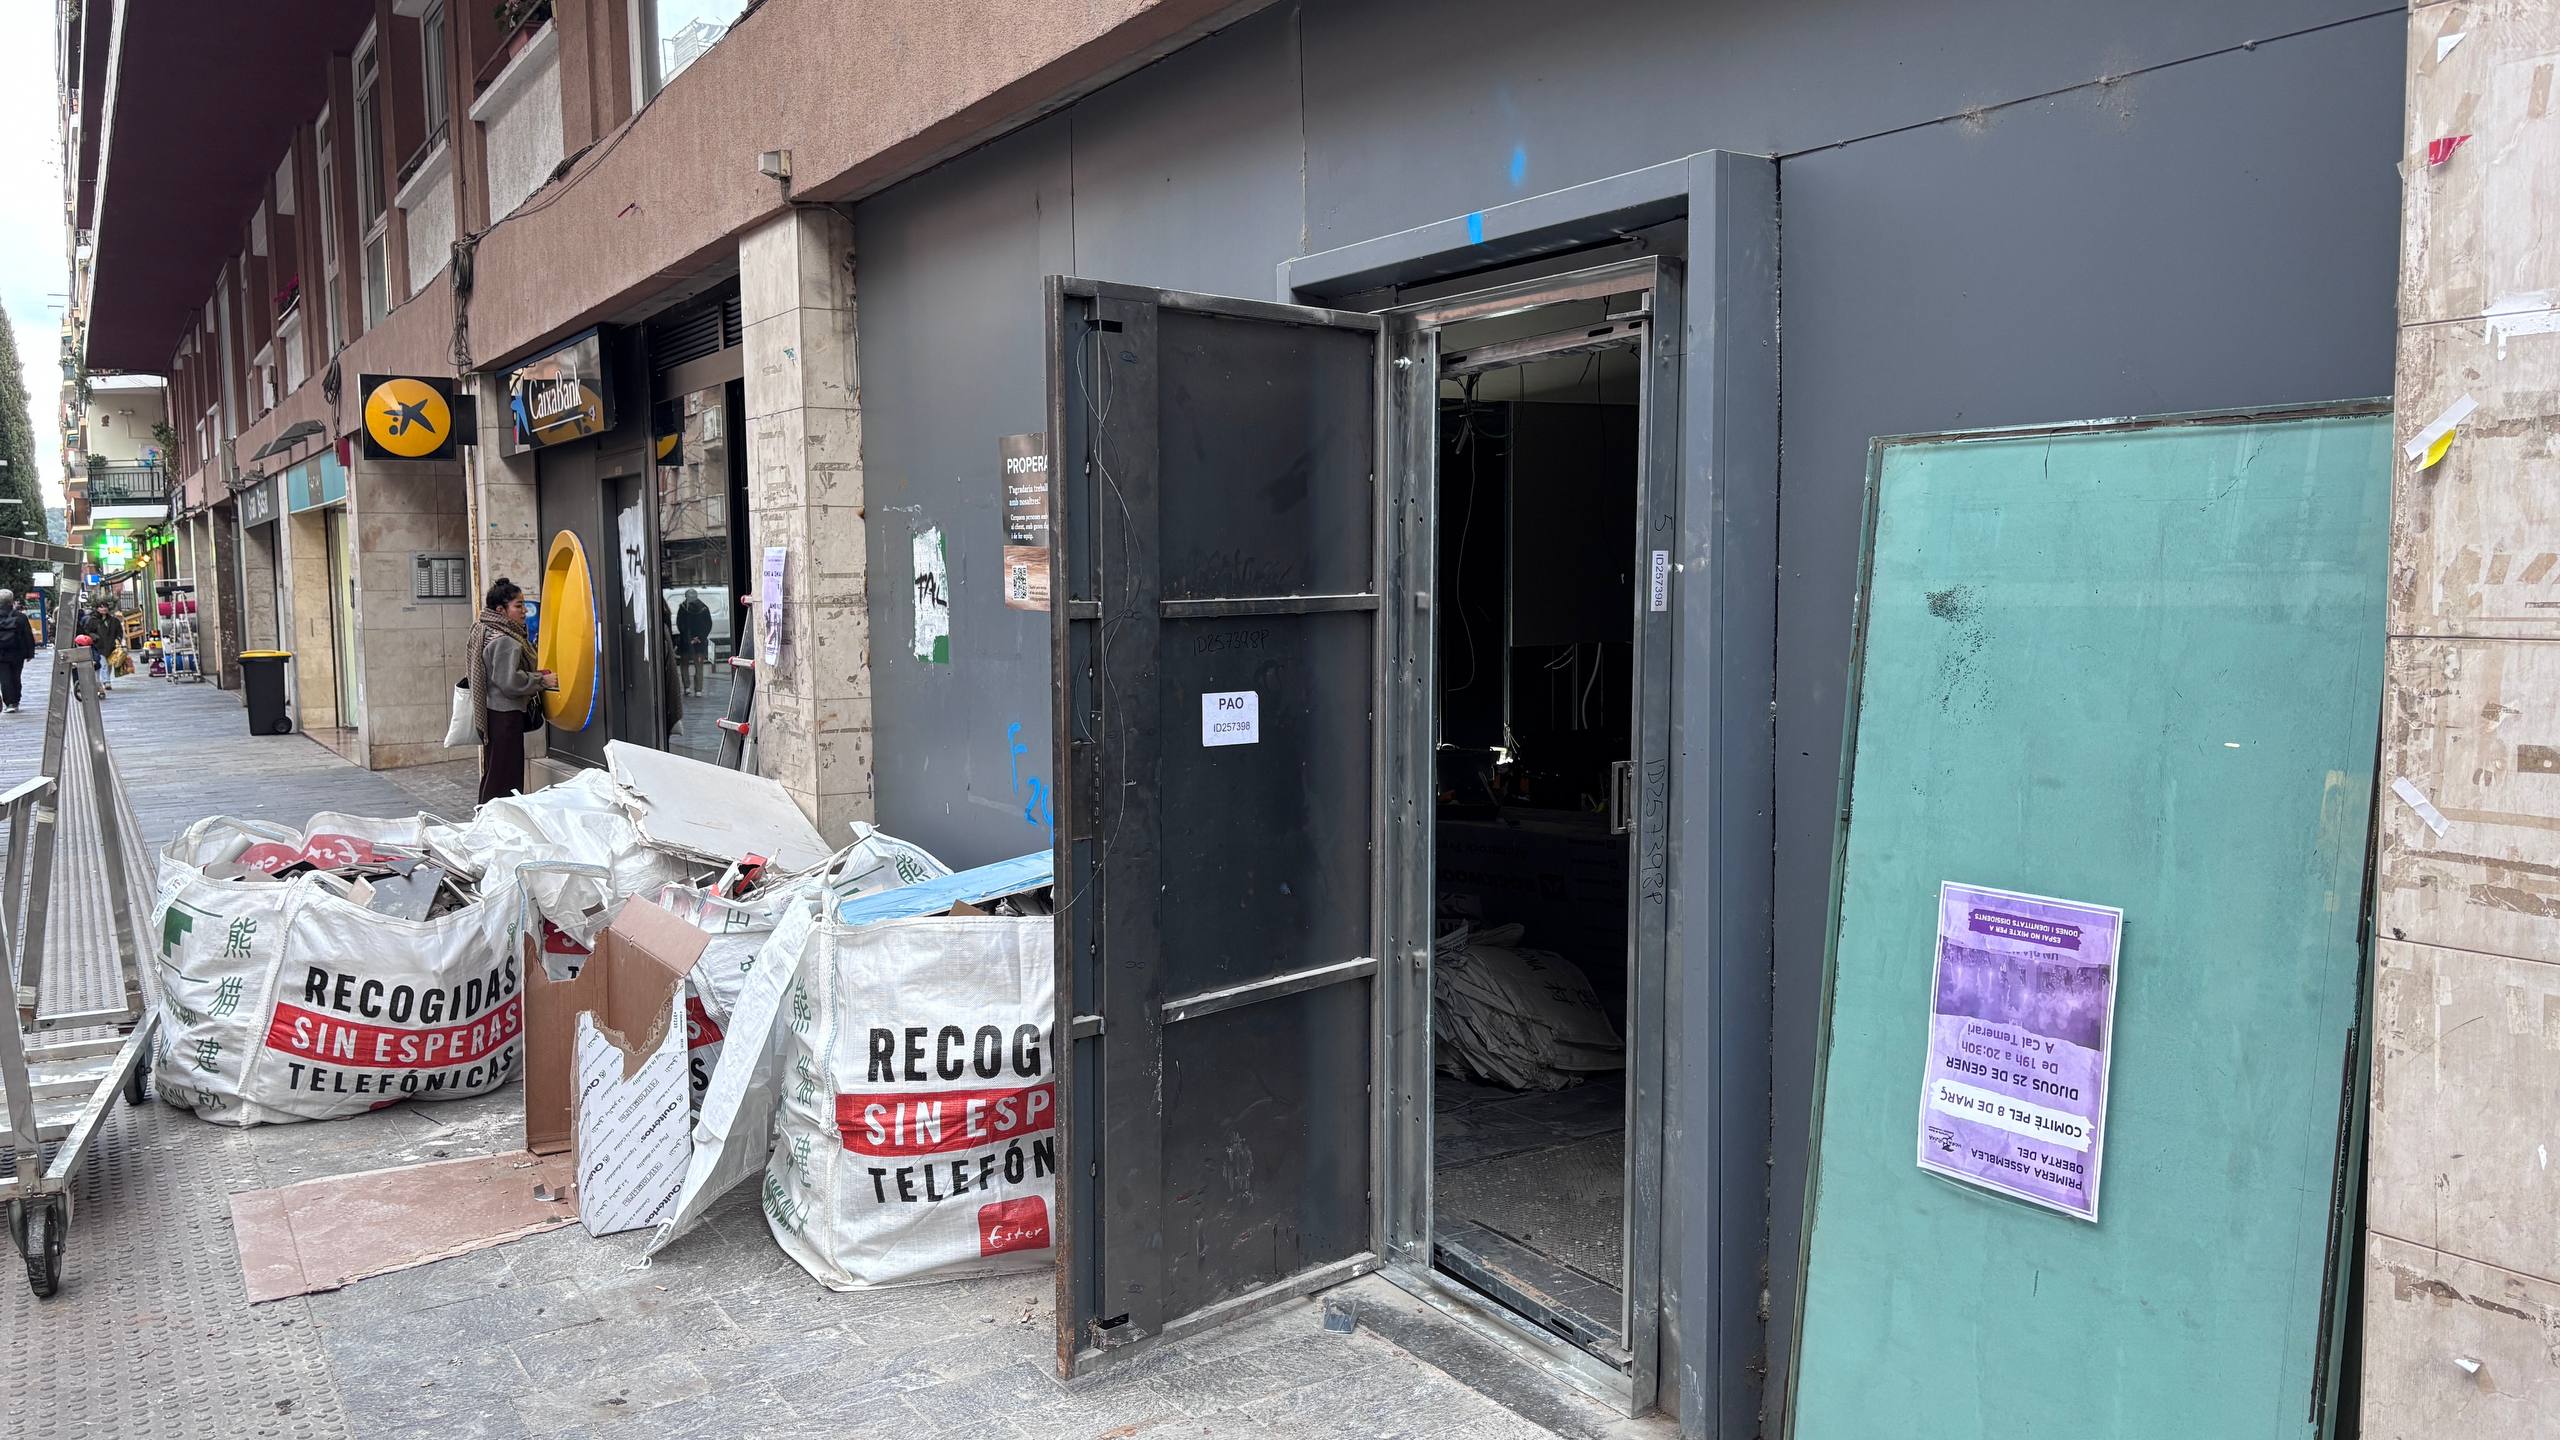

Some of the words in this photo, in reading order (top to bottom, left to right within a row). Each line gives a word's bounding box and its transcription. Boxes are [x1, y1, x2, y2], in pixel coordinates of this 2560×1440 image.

[528, 364, 583, 421] CaixaBank
[1654, 553, 1664, 607] ID257398
[1218, 696, 1244, 711] PAO
[1213, 721, 1251, 733] ID257398
[1974, 913, 2011, 926] DISSIDENTS
[2012, 920, 2050, 933] IDENTITATS
[1995, 926, 2008, 934] PER
[2009, 928, 2029, 938] MIXTE
[2030, 932, 2041, 940] NO
[2055, 928, 2079, 937] DONES
[2041, 934, 2061, 944] ESPAI
[304, 955, 517, 1025] RECOGIDAS
[291, 1016, 359, 1058] SIN
[375, 1002, 520, 1064] ESPERAS
[1967, 1023, 2018, 1047] Temerari
[1961, 1040, 2000, 1060] 20:30h
[2022, 1036, 2040, 1051] Cal
[2045, 1042, 2055, 1054] A
[2005, 1052, 2012, 1061] a
[2015, 1054, 2036, 1070] 19h
[288, 1045, 515, 1095] TELEFÓNICAS
[1946, 1056, 1987, 1076] GENER
[2042, 1060, 2058, 1075] De
[1991, 1067, 2008, 1082] DE
[2013, 1073, 2028, 1087] 25
[1939, 1086, 1974, 1109] MARÇ
[2032, 1078, 2079, 1101] DIJOUS
[1977, 1100, 1994, 1114] DE
[1997, 1105, 2005, 1117] 8
[639, 1100, 678, 1142] Quitérios
[864, 1101, 942, 1146] SIN
[966, 1089, 1050, 1139] ESP
[2009, 1108, 2031, 1124] PEL
[2035, 1115, 2082, 1138] COMITÈ
[1971, 1147, 2031, 1174] ASSEMBLEA
[2017, 1147, 2037, 1161] DEL
[867, 1136, 1055, 1204] TELEFÓN
[2041, 1153, 2084, 1175] OBERTA
[2034, 1167, 2083, 1191] PRIMERA
[643, 1183, 682, 1225] Quitérios
[988, 1225, 1043, 1250] Ester
